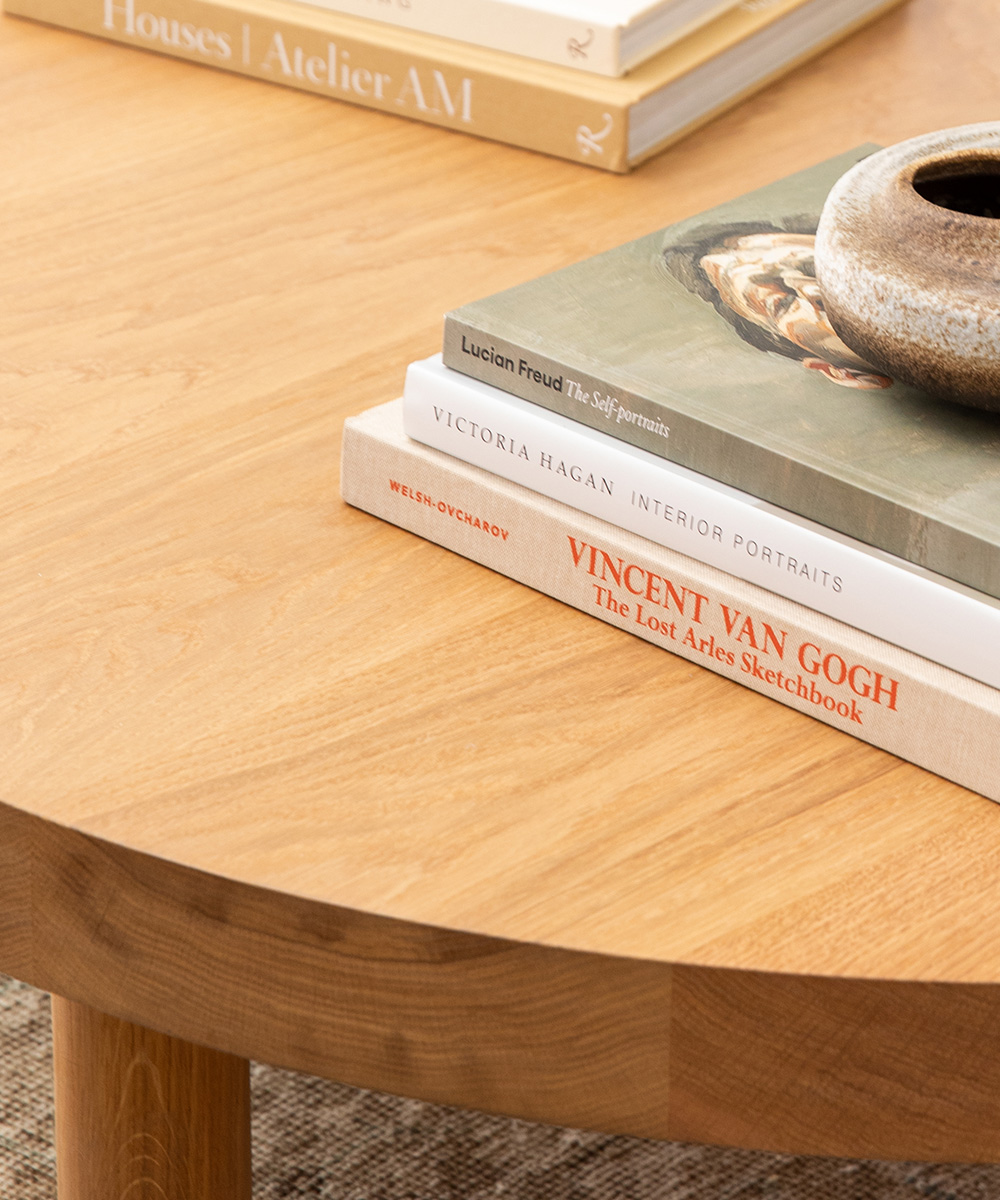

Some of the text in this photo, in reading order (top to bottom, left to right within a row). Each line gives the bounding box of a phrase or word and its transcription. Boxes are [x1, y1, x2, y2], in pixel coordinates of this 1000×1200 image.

[261, 30, 392, 101] Atelier
[395, 66, 473, 123] AM
[566, 26, 595, 59] R
[576, 111, 614, 156] R
[460, 335, 671, 439] Lucian Freud The Self-portraits
[388, 478, 511, 543] WELSH-OVCHAROV
[432, 404, 844, 594] VICTORIA HAGAN INTERIOR PORTRAITS
[567, 535, 900, 713] VINCENT VAN GOGH
[592, 583, 864, 726] The Lost Arles Sketchbook
